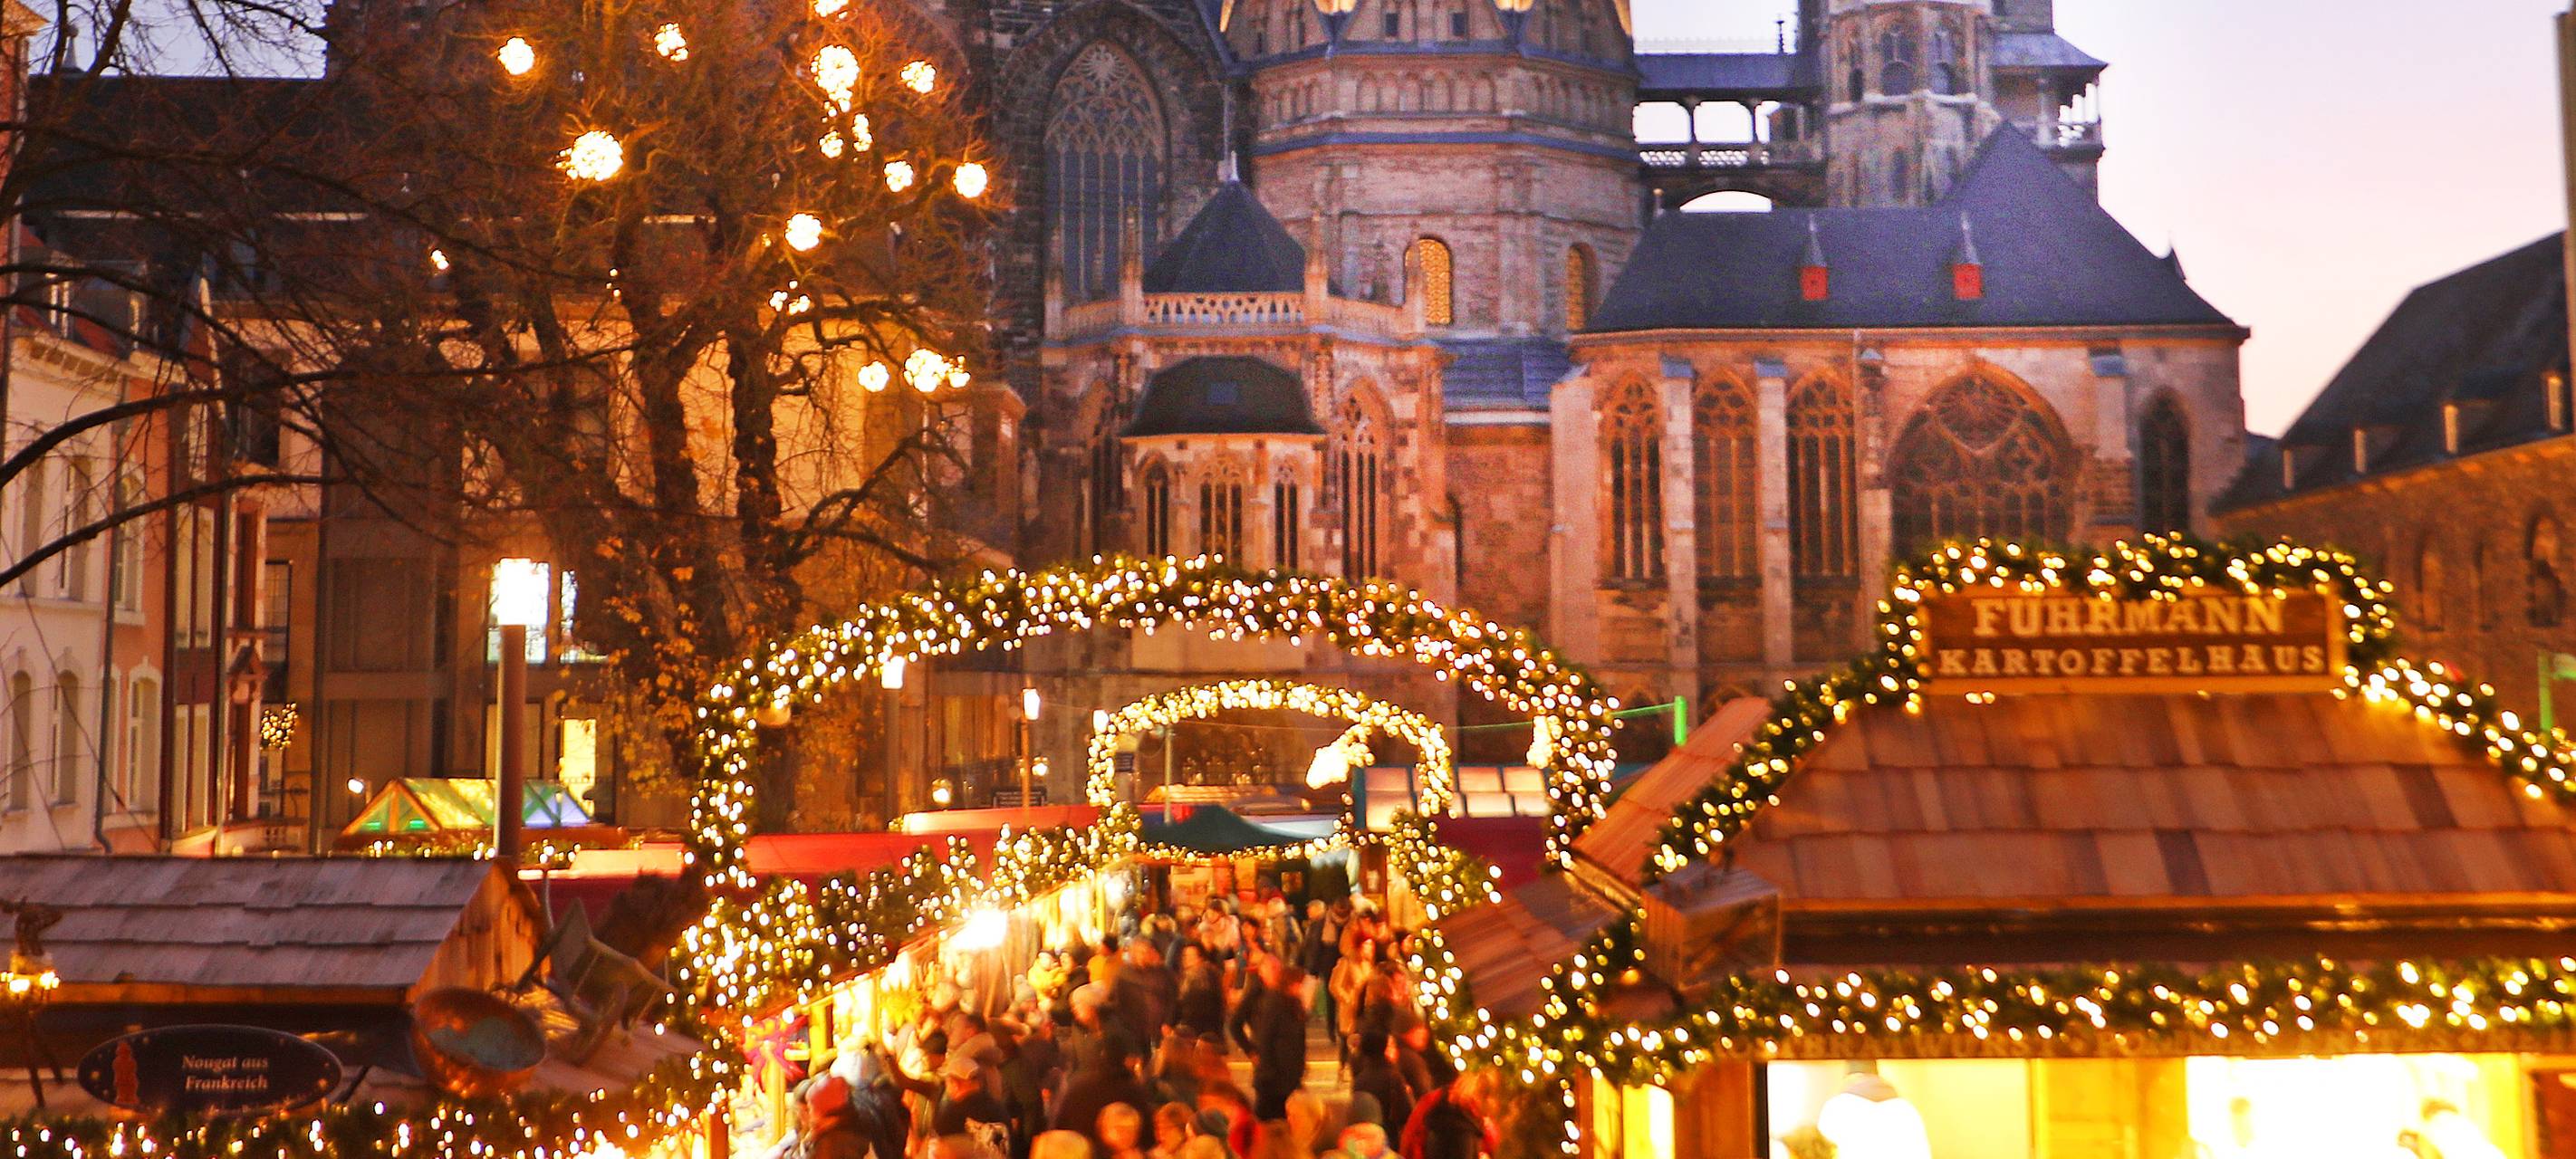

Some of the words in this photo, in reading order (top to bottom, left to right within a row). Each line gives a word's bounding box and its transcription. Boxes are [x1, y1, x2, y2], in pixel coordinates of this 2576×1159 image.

[1972, 598, 2284, 637] FUHRMANN
[1938, 644, 2324, 676] KARTOFFELHAUS
[181, 1055, 237, 1071] Nougat
[242, 1056, 269, 1069] aus
[185, 1075, 268, 1090] Frankreich
